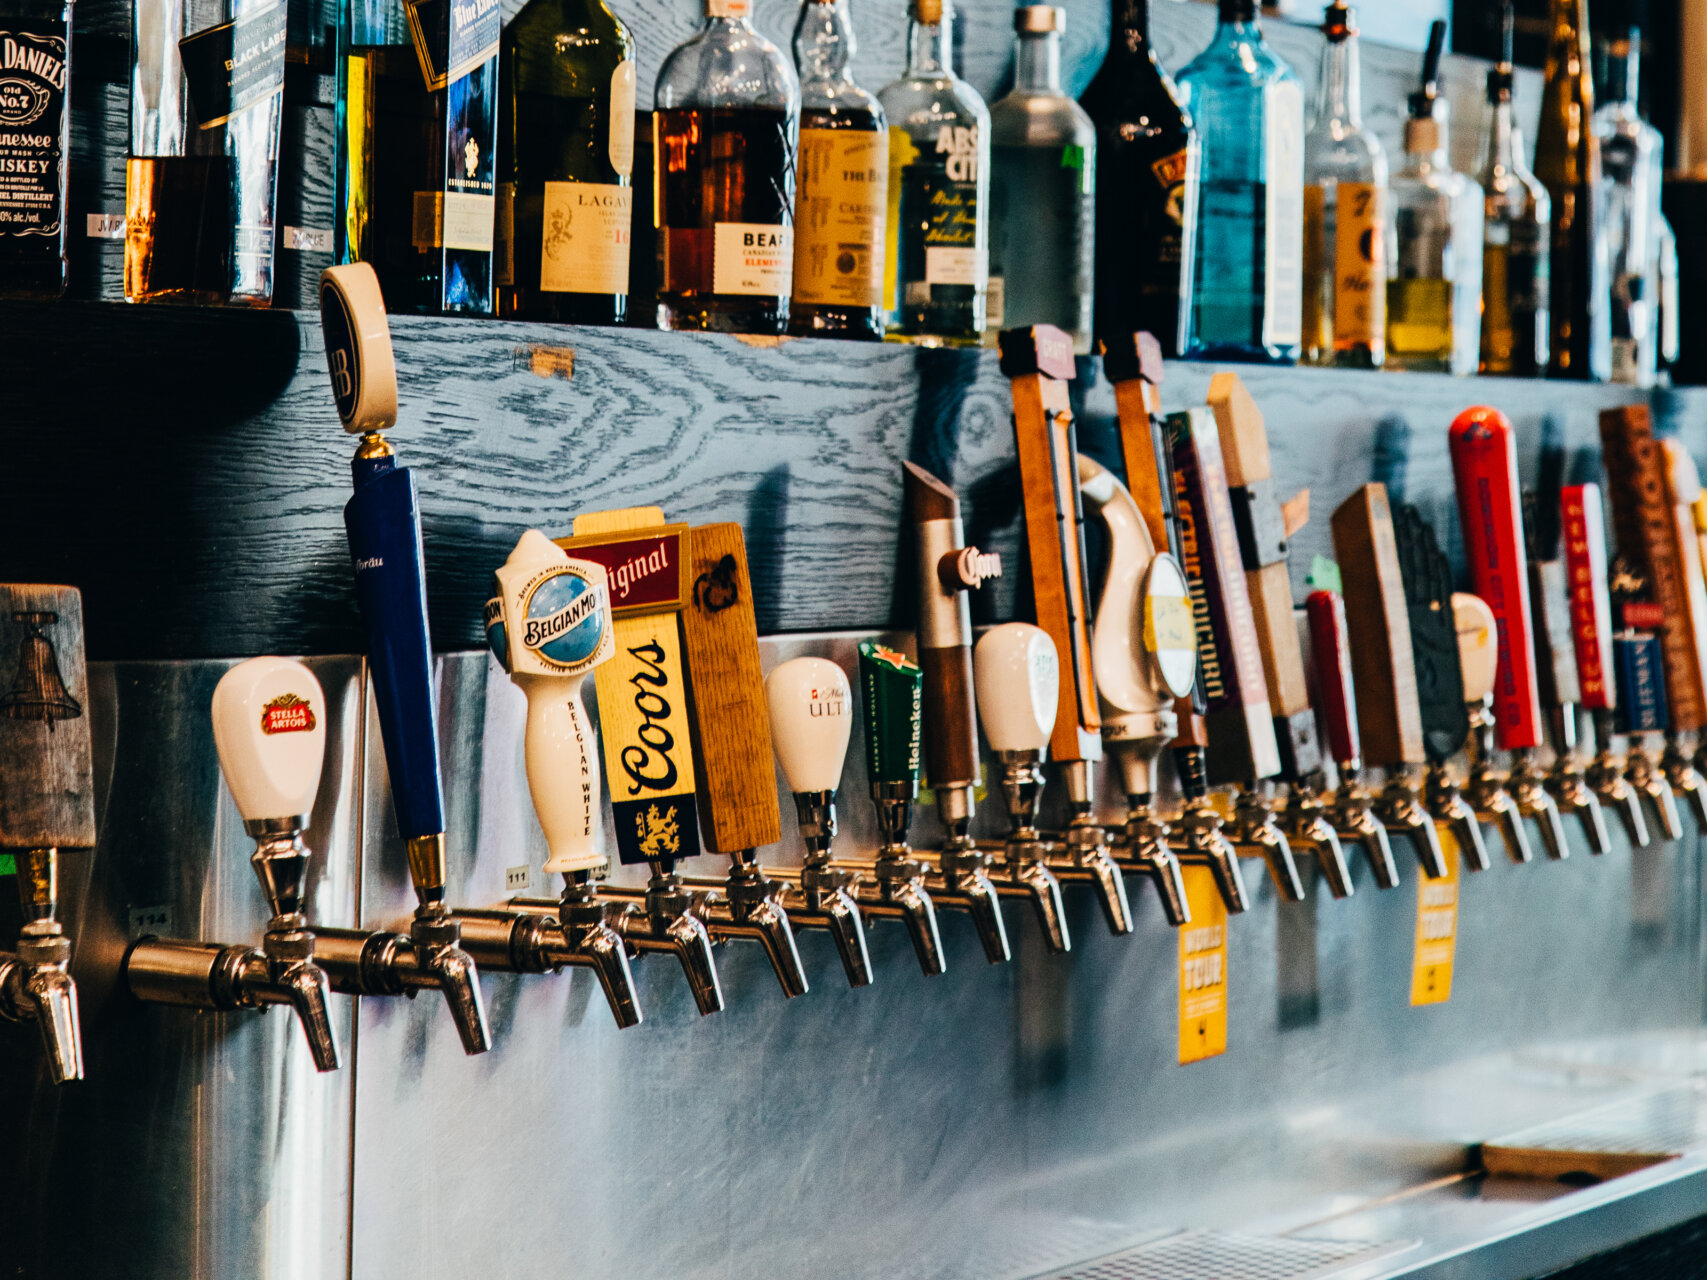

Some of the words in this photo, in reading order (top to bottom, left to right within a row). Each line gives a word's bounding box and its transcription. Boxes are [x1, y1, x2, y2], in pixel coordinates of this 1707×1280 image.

[453, 2, 477, 32] Blue
[224, 45, 261, 72] BLACK
[3, 86, 21, 95] Old
[12, 149, 33, 157] MASH
[12, 192, 54, 202] DISTILLERY
[523, 605, 581, 647] BELGIAN
[270, 708, 306, 720] STELLA
[621, 637, 679, 796] Coors
[270, 717, 307, 730] ARTOIS
[908, 684, 921, 771] Heineken
[567, 701, 589, 776] BELGIAN
[581, 782, 591, 837] WHITE
[508, 871, 527, 884] 111
[135, 912, 168, 927] 114
